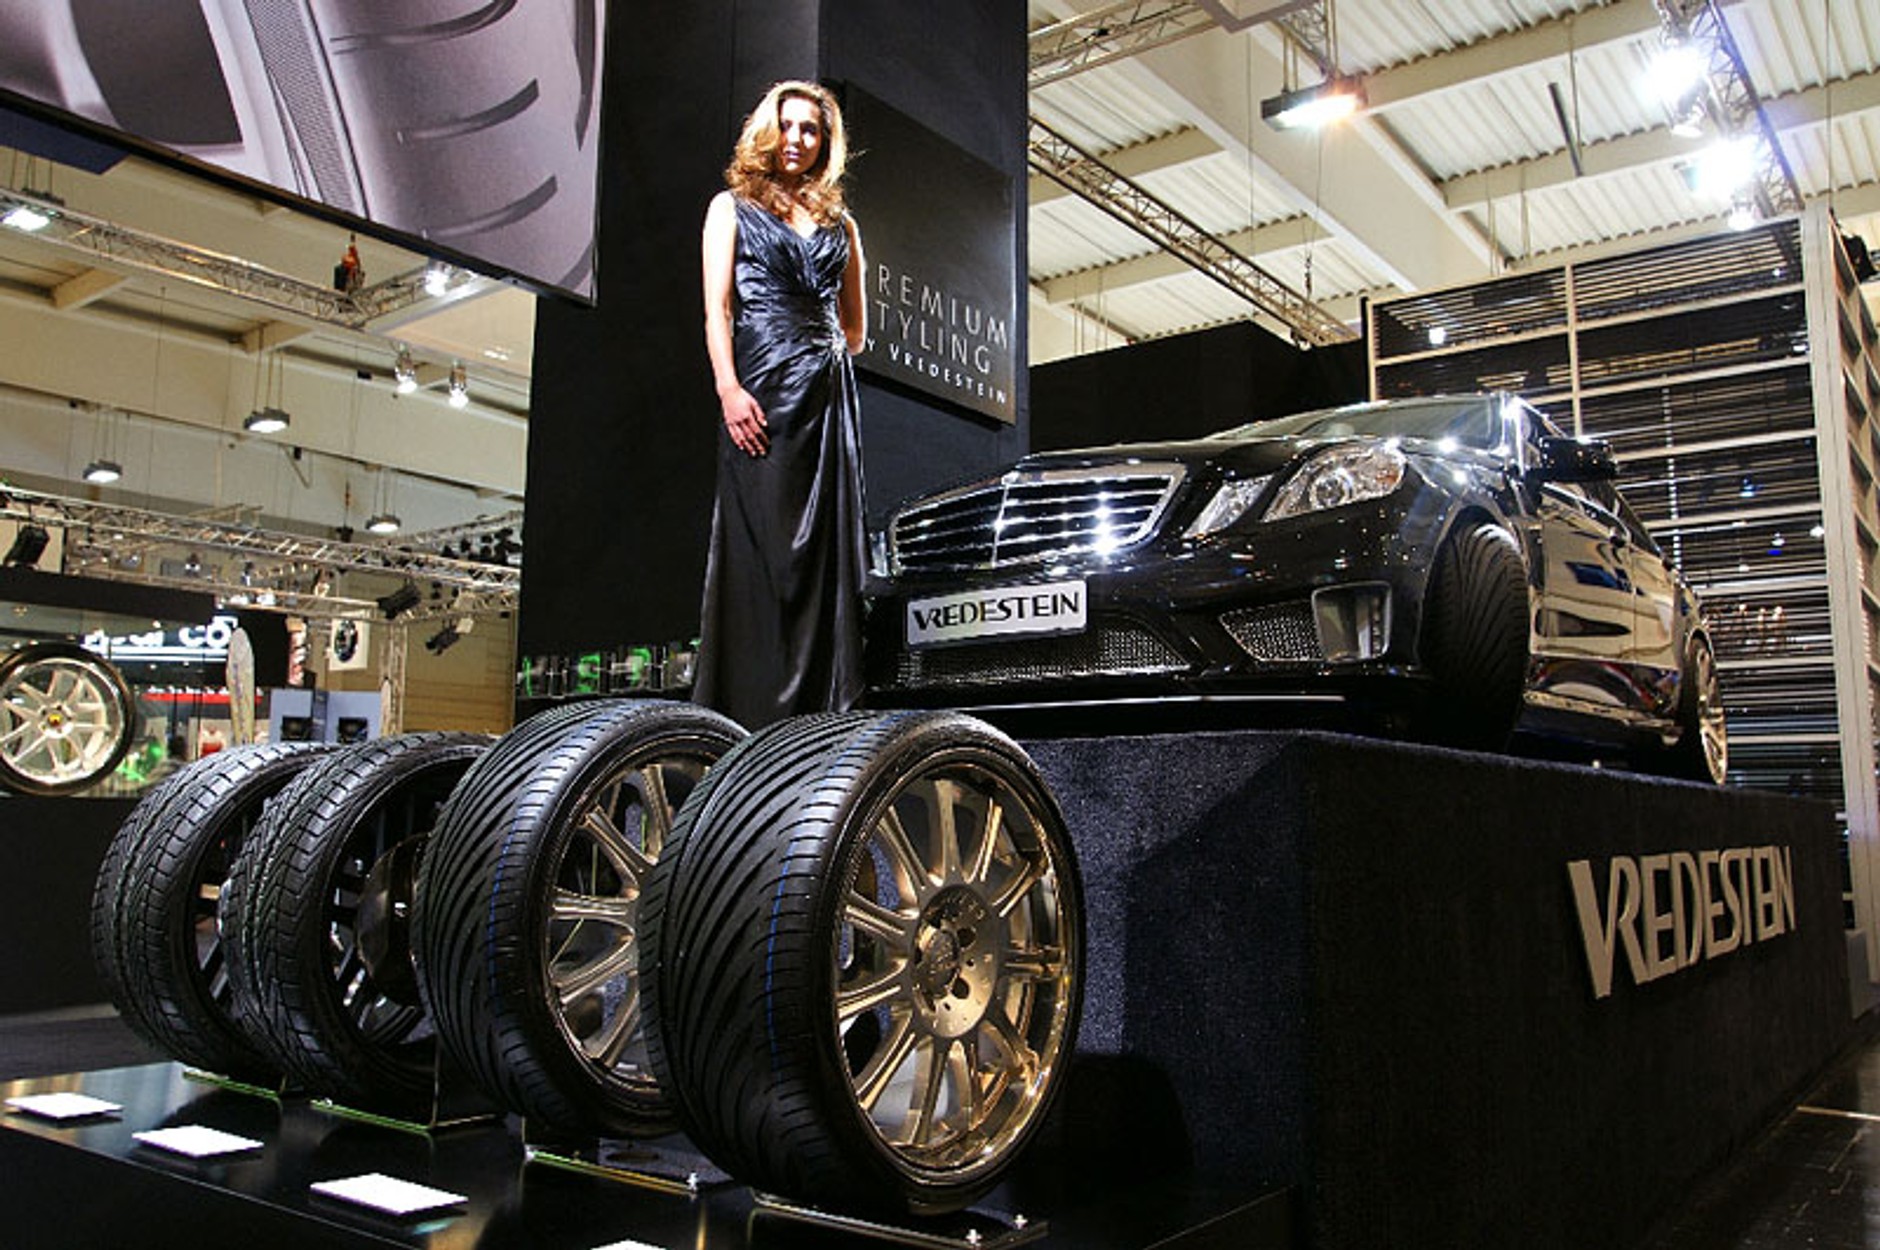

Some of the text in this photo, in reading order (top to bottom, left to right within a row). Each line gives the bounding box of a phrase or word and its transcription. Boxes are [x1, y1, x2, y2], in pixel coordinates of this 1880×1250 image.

[875, 300, 990, 374] TYLING
[878, 263, 1007, 350] REMIUM
[913, 592, 1078, 630] VREDESTEIN
[1567, 845, 1796, 1000] VREDESTEIN
